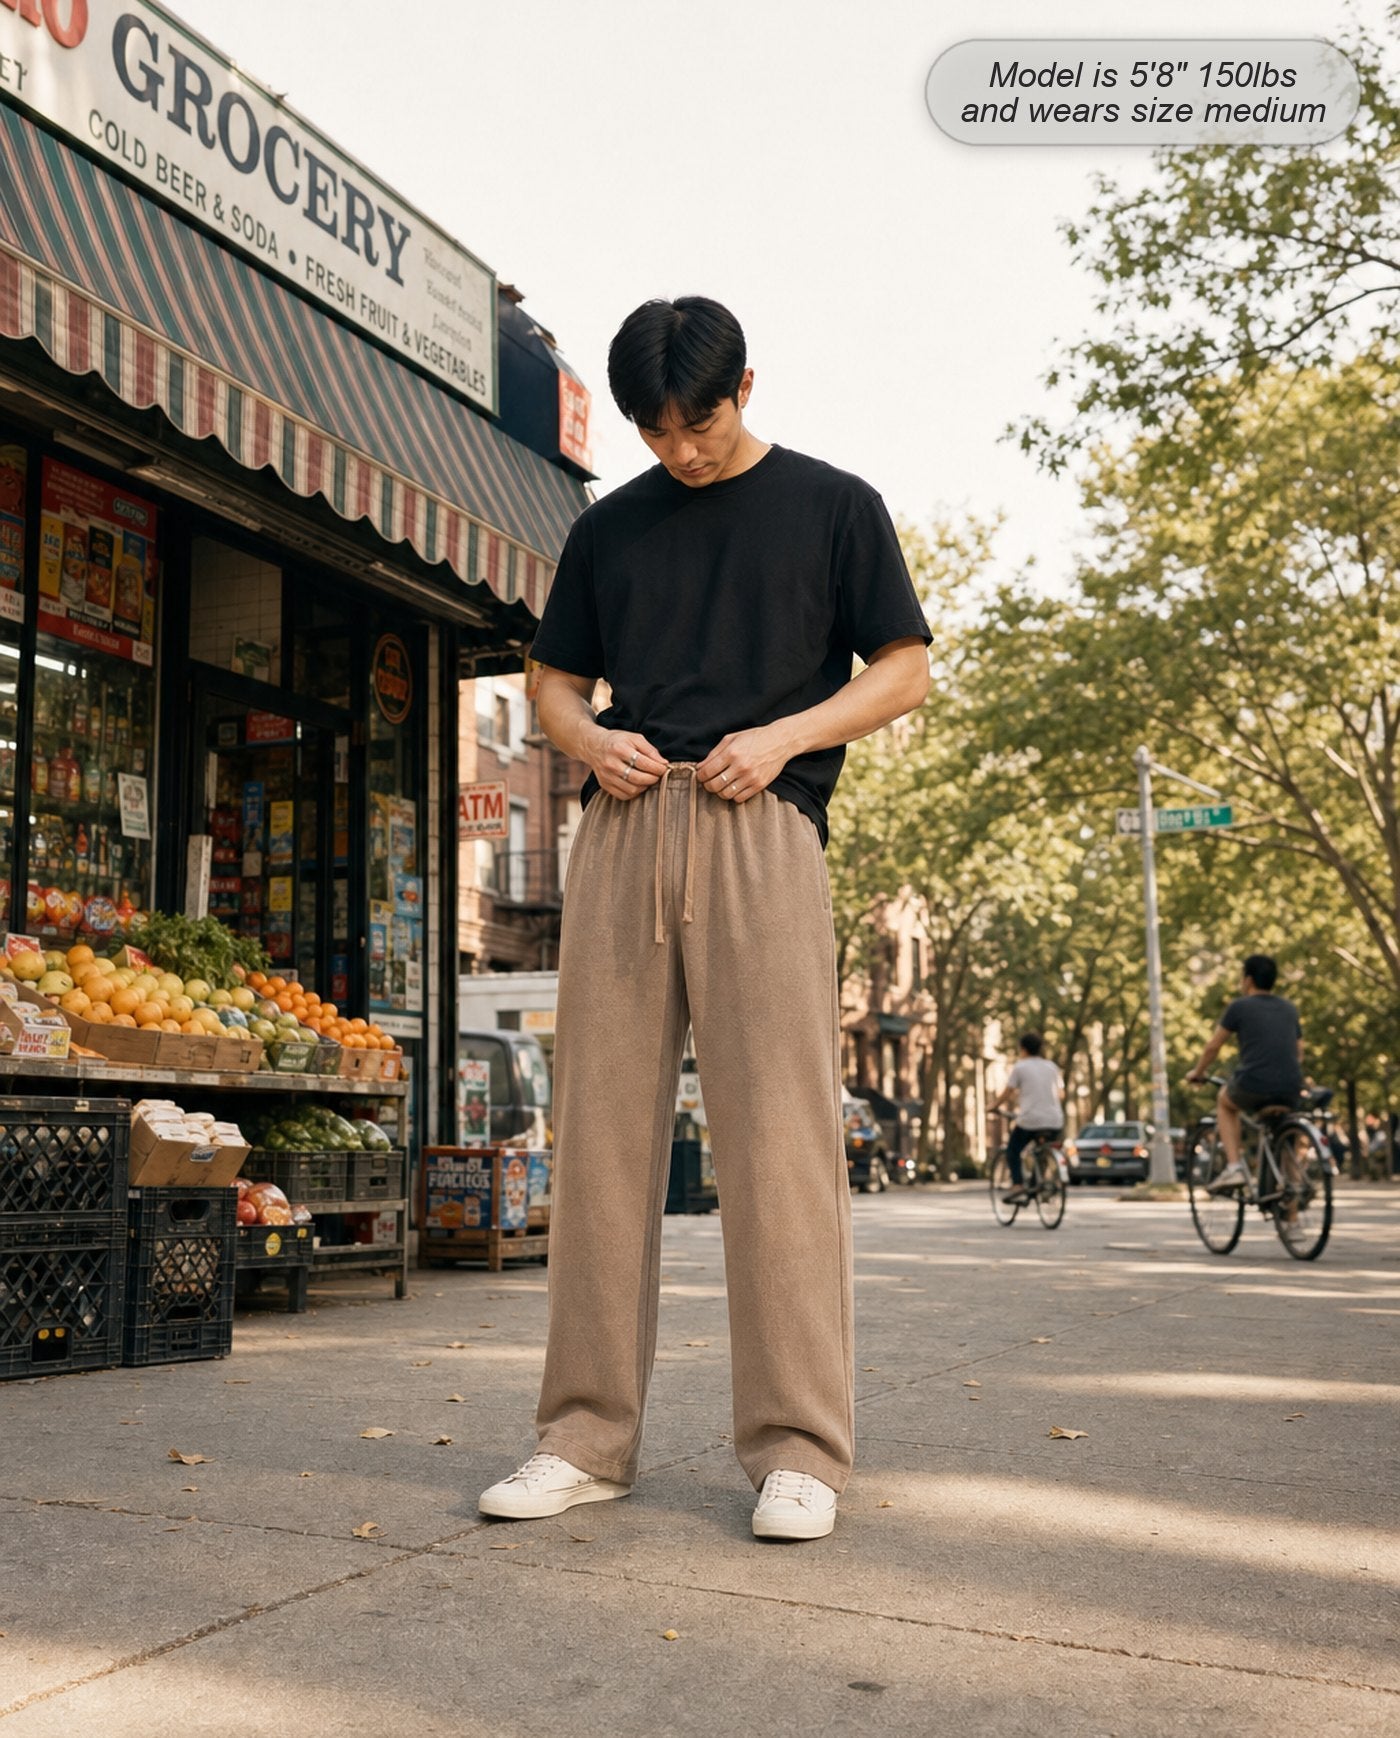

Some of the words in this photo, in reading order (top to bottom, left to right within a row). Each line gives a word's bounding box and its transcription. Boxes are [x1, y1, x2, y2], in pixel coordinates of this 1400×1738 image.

[88, 109, 147, 169] COLD
[156, 152, 207, 212] BEER
[213, 193, 226, 224] &
[231, 204, 279, 260] SODA
[305, 255, 356, 311] FRESH
[360, 292, 399, 339] FRUIT
[401, 322, 413, 349] &
[414, 328, 487, 397] VEGETABLES
[111, 13, 412, 287] GROCERY
[459, 791, 503, 821] ATM
